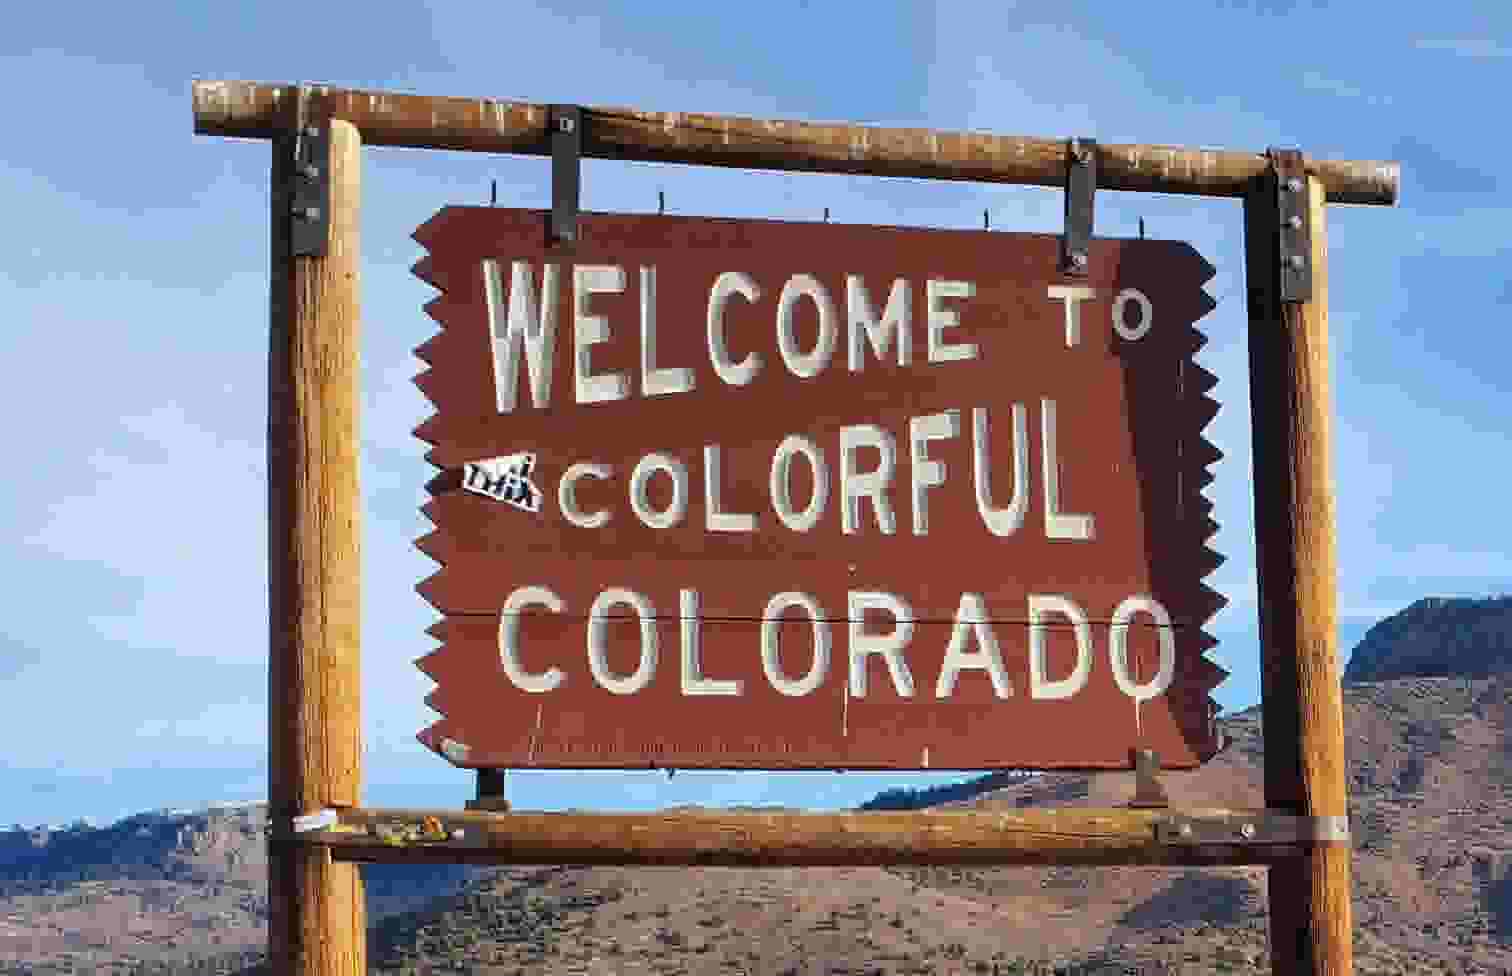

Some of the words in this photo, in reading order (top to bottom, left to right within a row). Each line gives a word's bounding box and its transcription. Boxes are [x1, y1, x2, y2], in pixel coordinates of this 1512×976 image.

[481, 259, 980, 414] WELCOME
[1047, 284, 1154, 349] TO
[556, 399, 1098, 541] COLORFUL
[496, 584, 1177, 703] COLORADO
